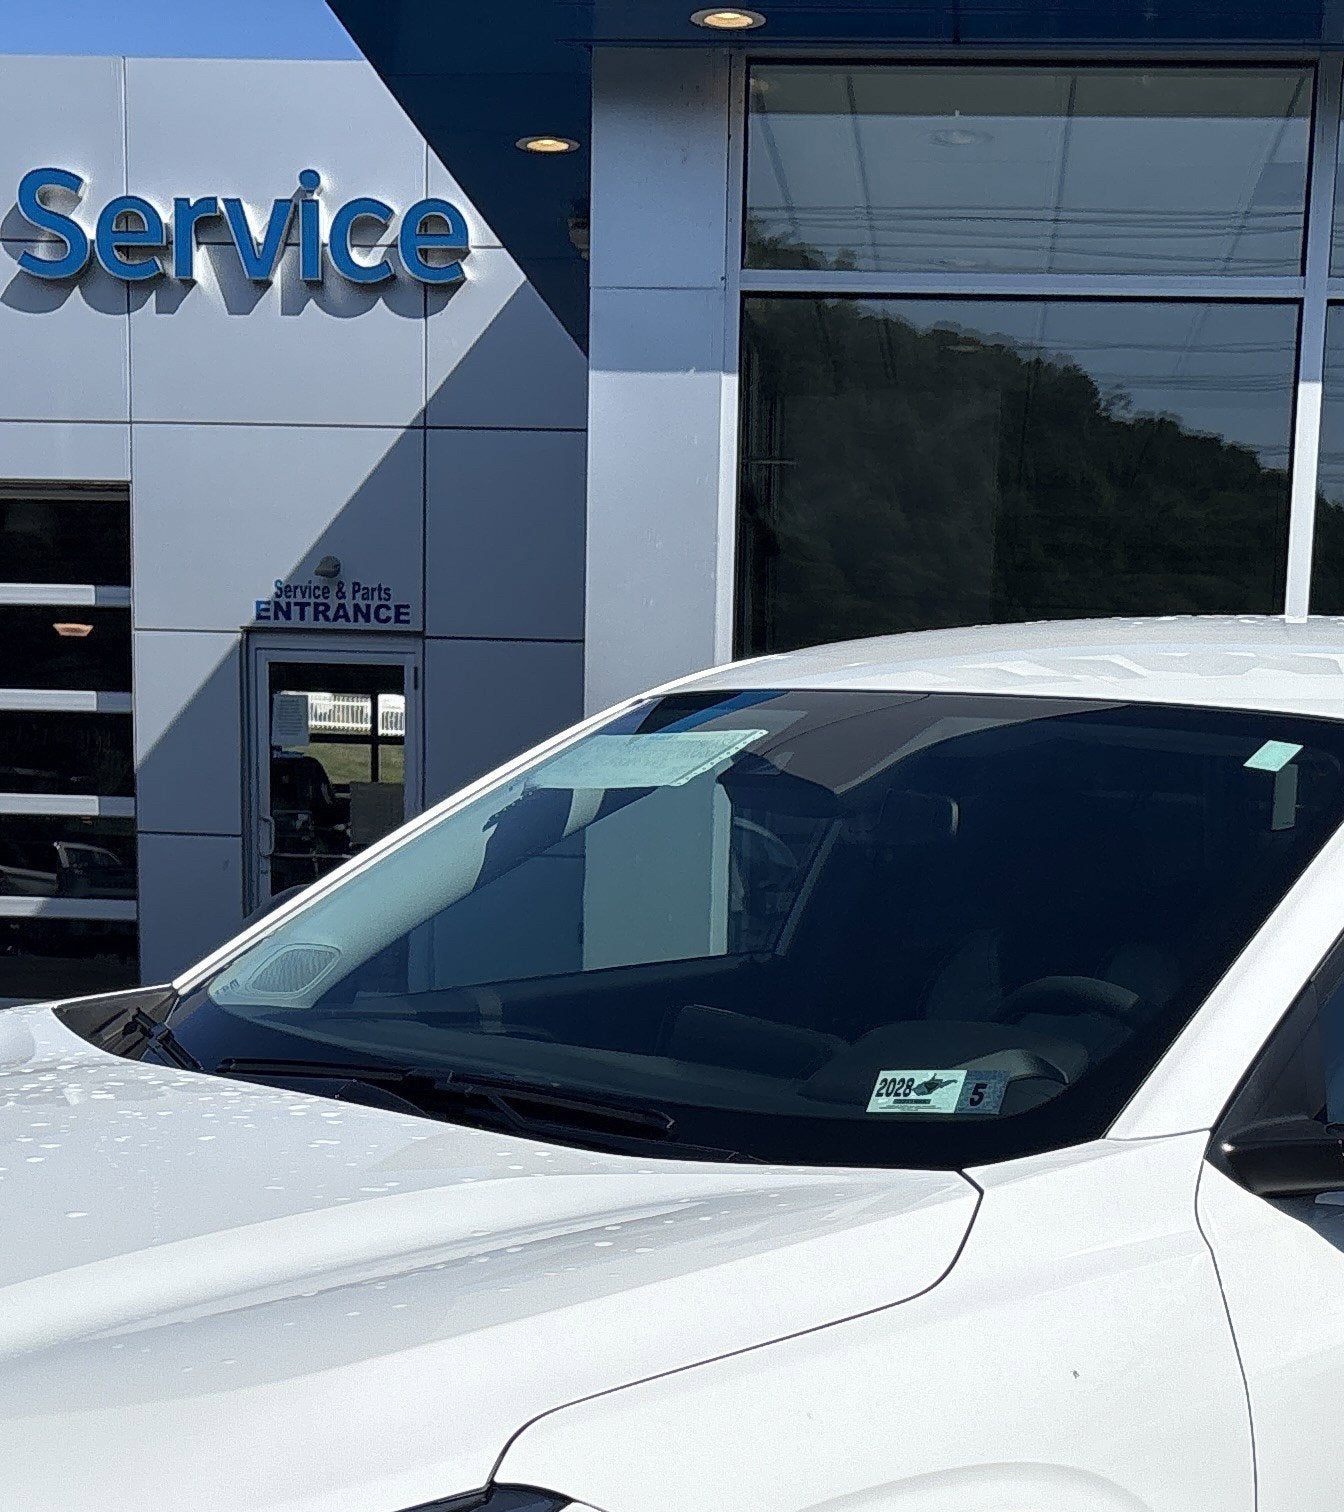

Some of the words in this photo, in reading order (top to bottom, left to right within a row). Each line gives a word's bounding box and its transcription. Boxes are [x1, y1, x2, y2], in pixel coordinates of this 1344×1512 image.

[17, 167, 471, 283] Service
[274, 579, 331, 601] Service
[336, 580, 347, 600] &
[352, 581, 392, 602] Parts
[255, 600, 411, 625] ENTRANCE
[875, 1077, 915, 1098] 2028
[969, 1082, 988, 1107] 5
